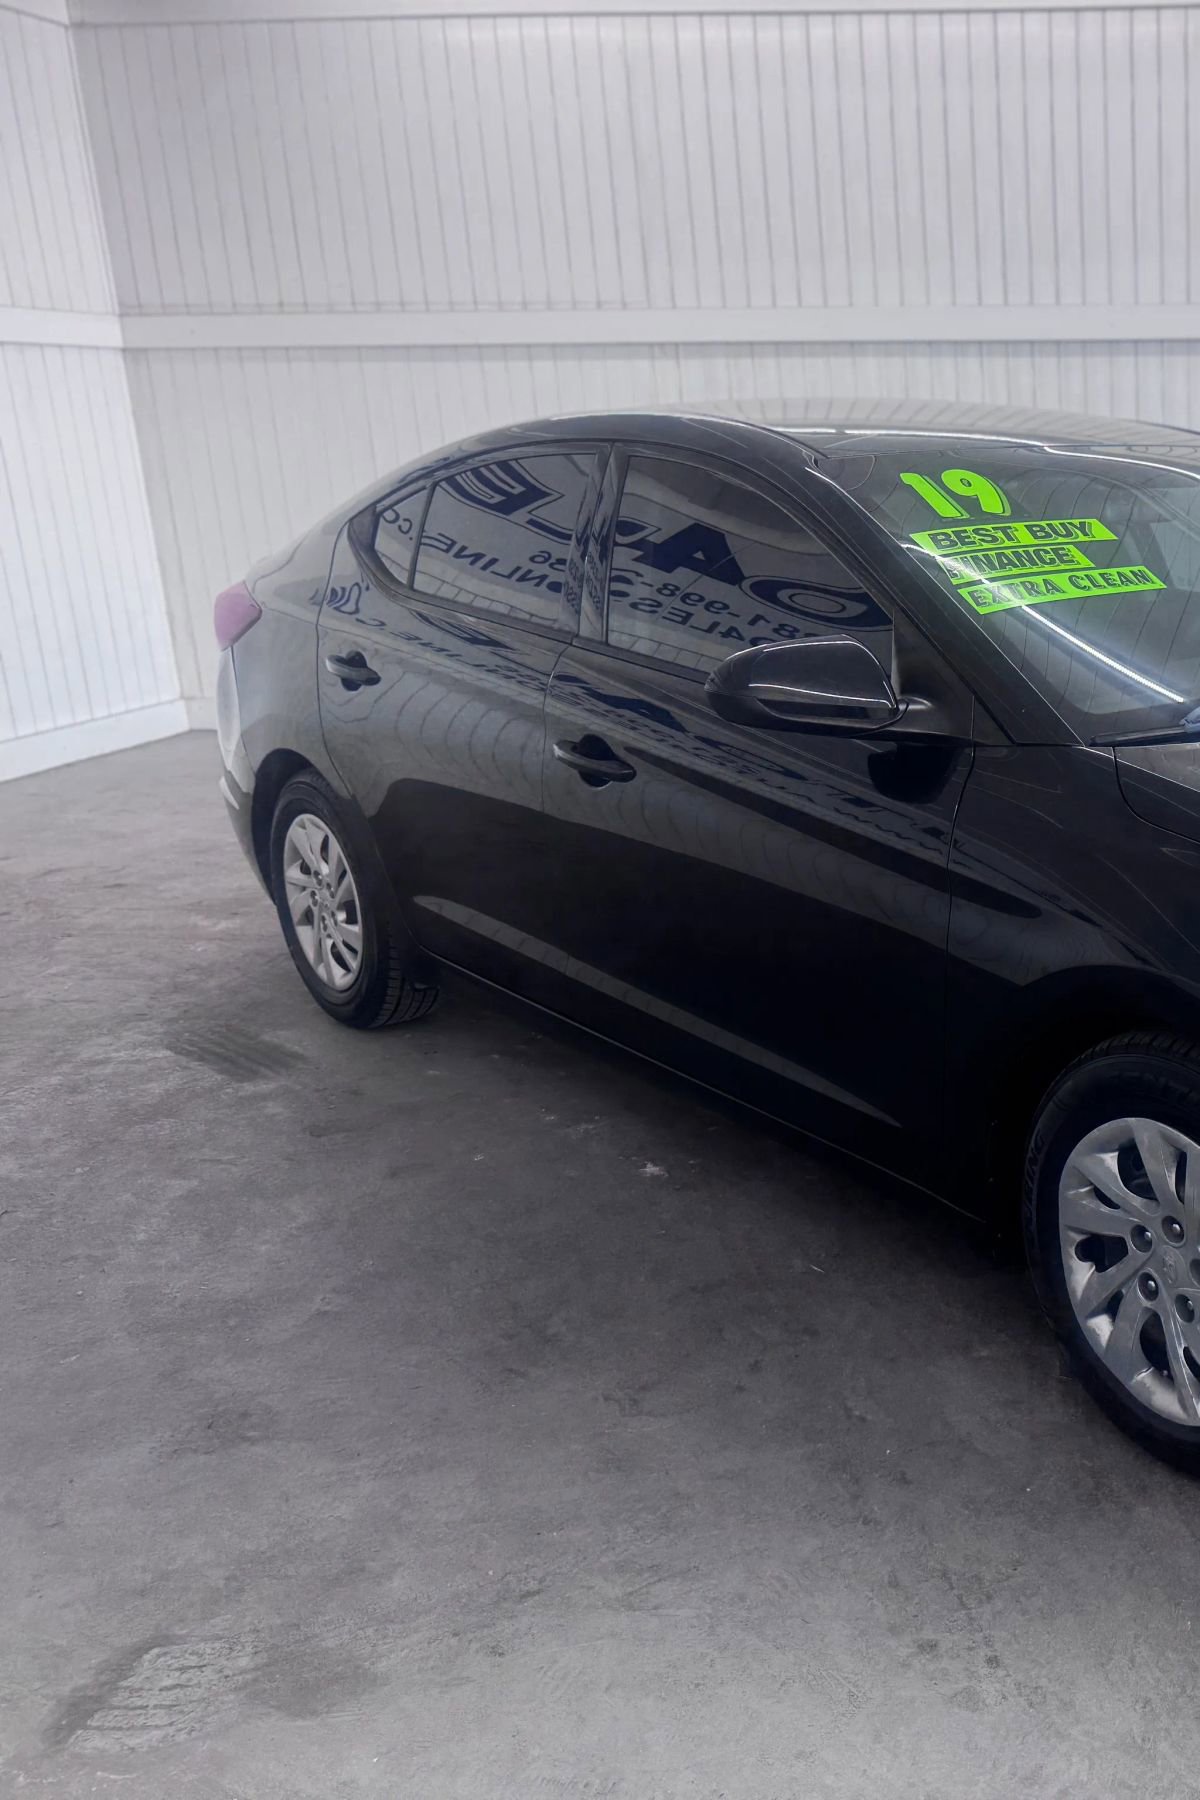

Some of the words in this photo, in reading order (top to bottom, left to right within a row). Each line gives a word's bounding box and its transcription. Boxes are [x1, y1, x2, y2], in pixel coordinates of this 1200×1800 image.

[900, 468, 1011, 519] 19
[928, 525, 1019, 550] BEST
[1023, 520, 1096, 542] BUY
[970, 578, 1063, 609] EXTRA
[1068, 569, 1155, 592] CLEAN
